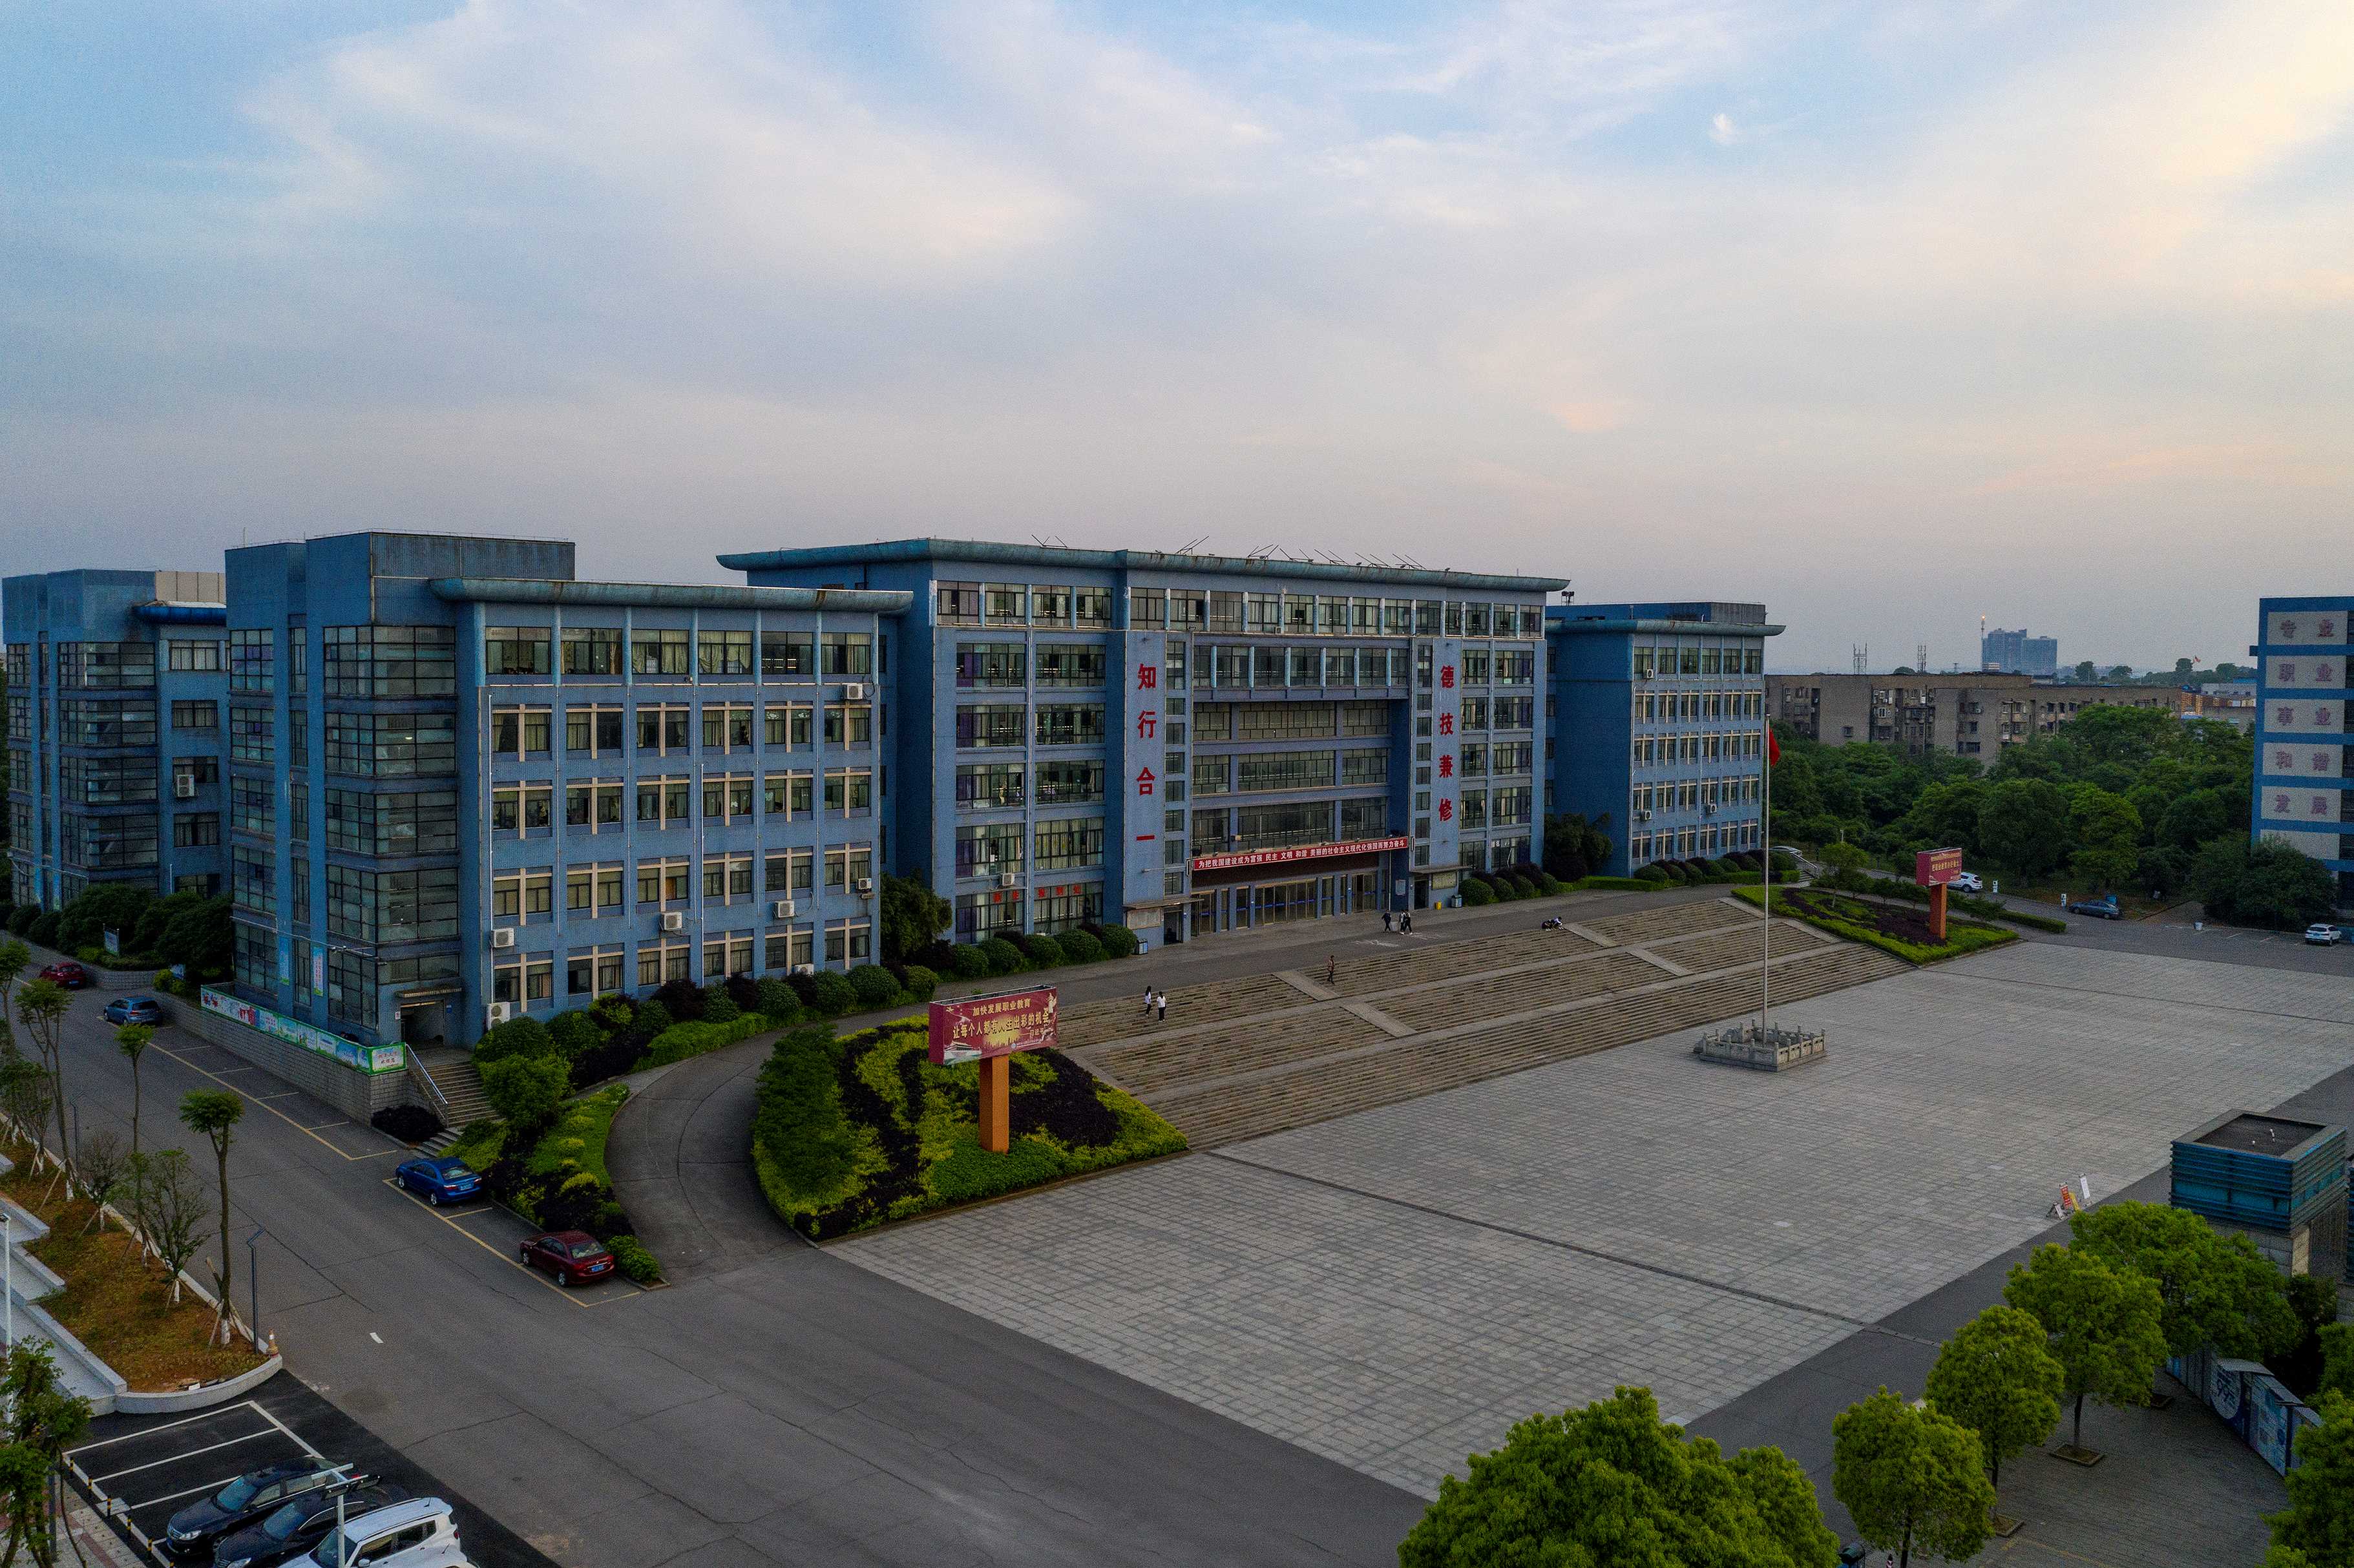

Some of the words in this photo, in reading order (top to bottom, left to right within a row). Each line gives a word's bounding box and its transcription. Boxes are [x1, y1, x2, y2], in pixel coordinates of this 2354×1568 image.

[1136, 663, 1157, 841] 知行合一
[1438, 665, 1455, 822] 德技兼修
[1199, 855, 1263, 868] 为把我国建设成为富强
[1281, 851, 1293, 859] 文明
[1296, 849, 1307, 857] 和谐
[952, 1007, 1050, 1039] 让每个人都有人生出彩的机会
[972, 998, 1031, 1017] 加快发展职业教育
